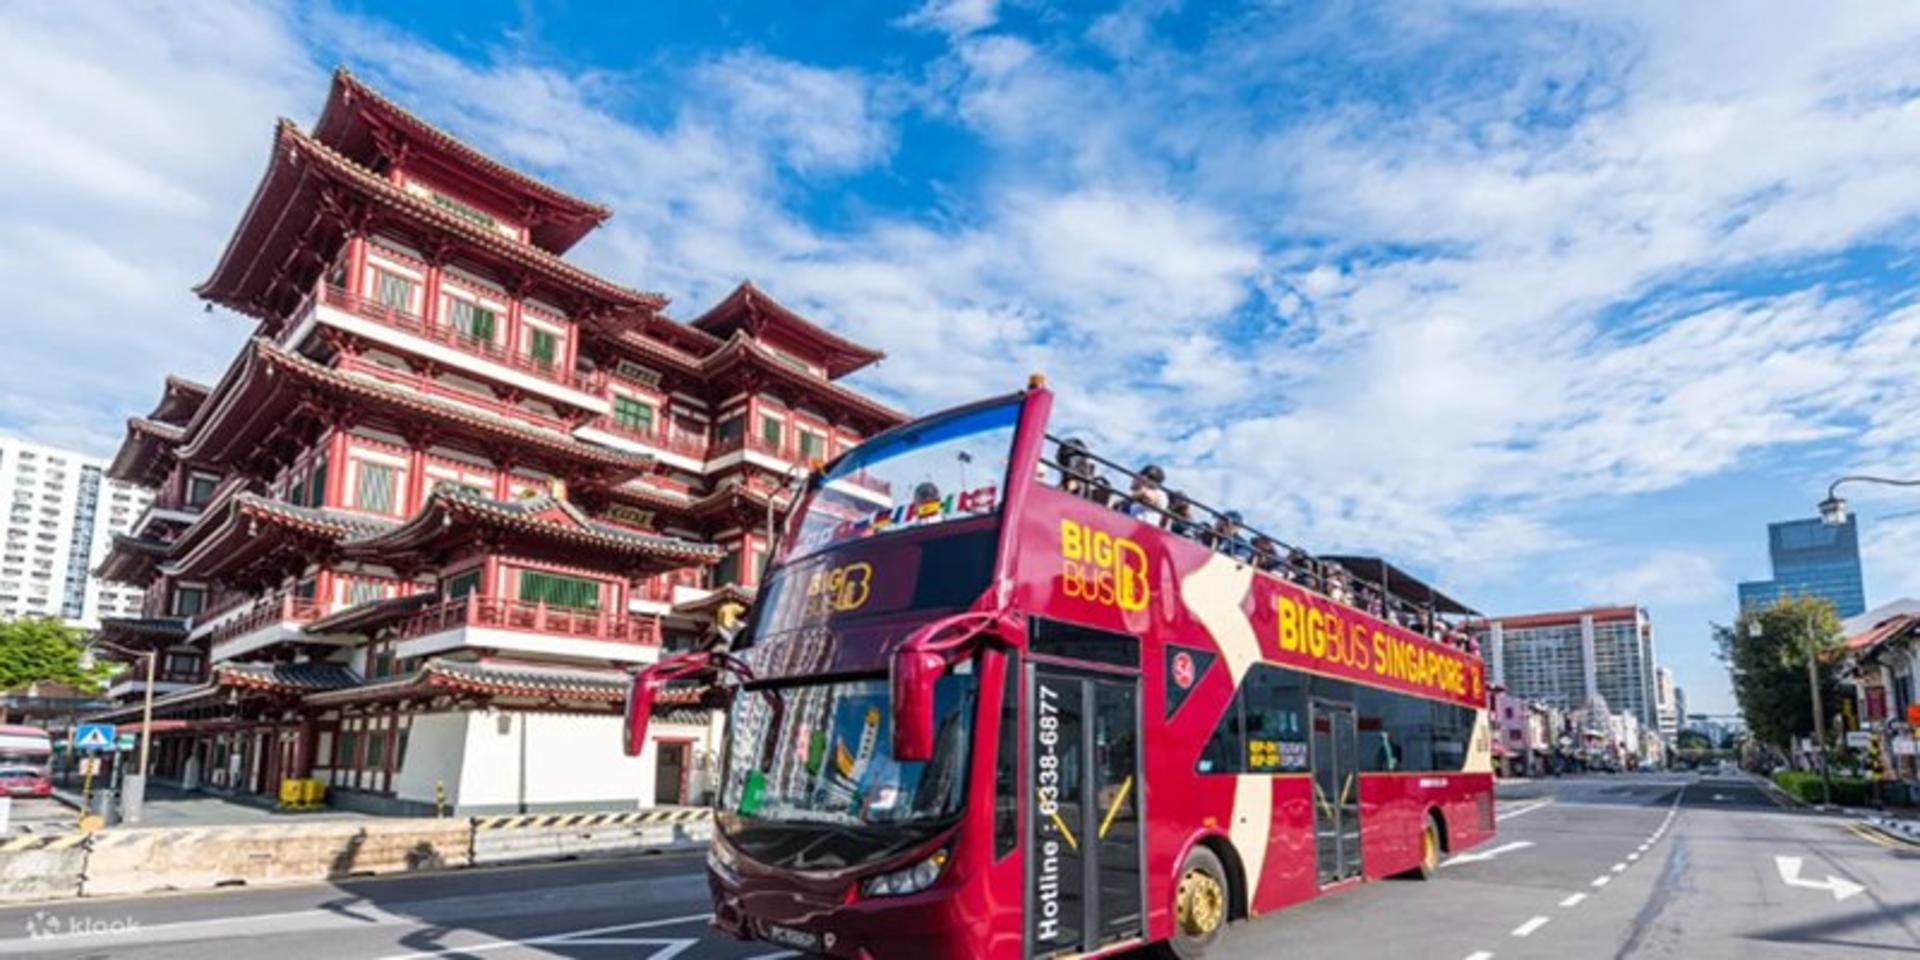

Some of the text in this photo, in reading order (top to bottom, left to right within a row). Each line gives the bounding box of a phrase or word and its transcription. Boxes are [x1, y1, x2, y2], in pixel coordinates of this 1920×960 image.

[1061, 518, 1112, 568] BIG
[807, 568, 844, 597] BIG
[1062, 560, 1115, 606] BUS
[1373, 631, 1465, 694] SINGAPORE
[1039, 685, 1058, 815] 6338-6877
[1039, 841, 1058, 941] Hotline
